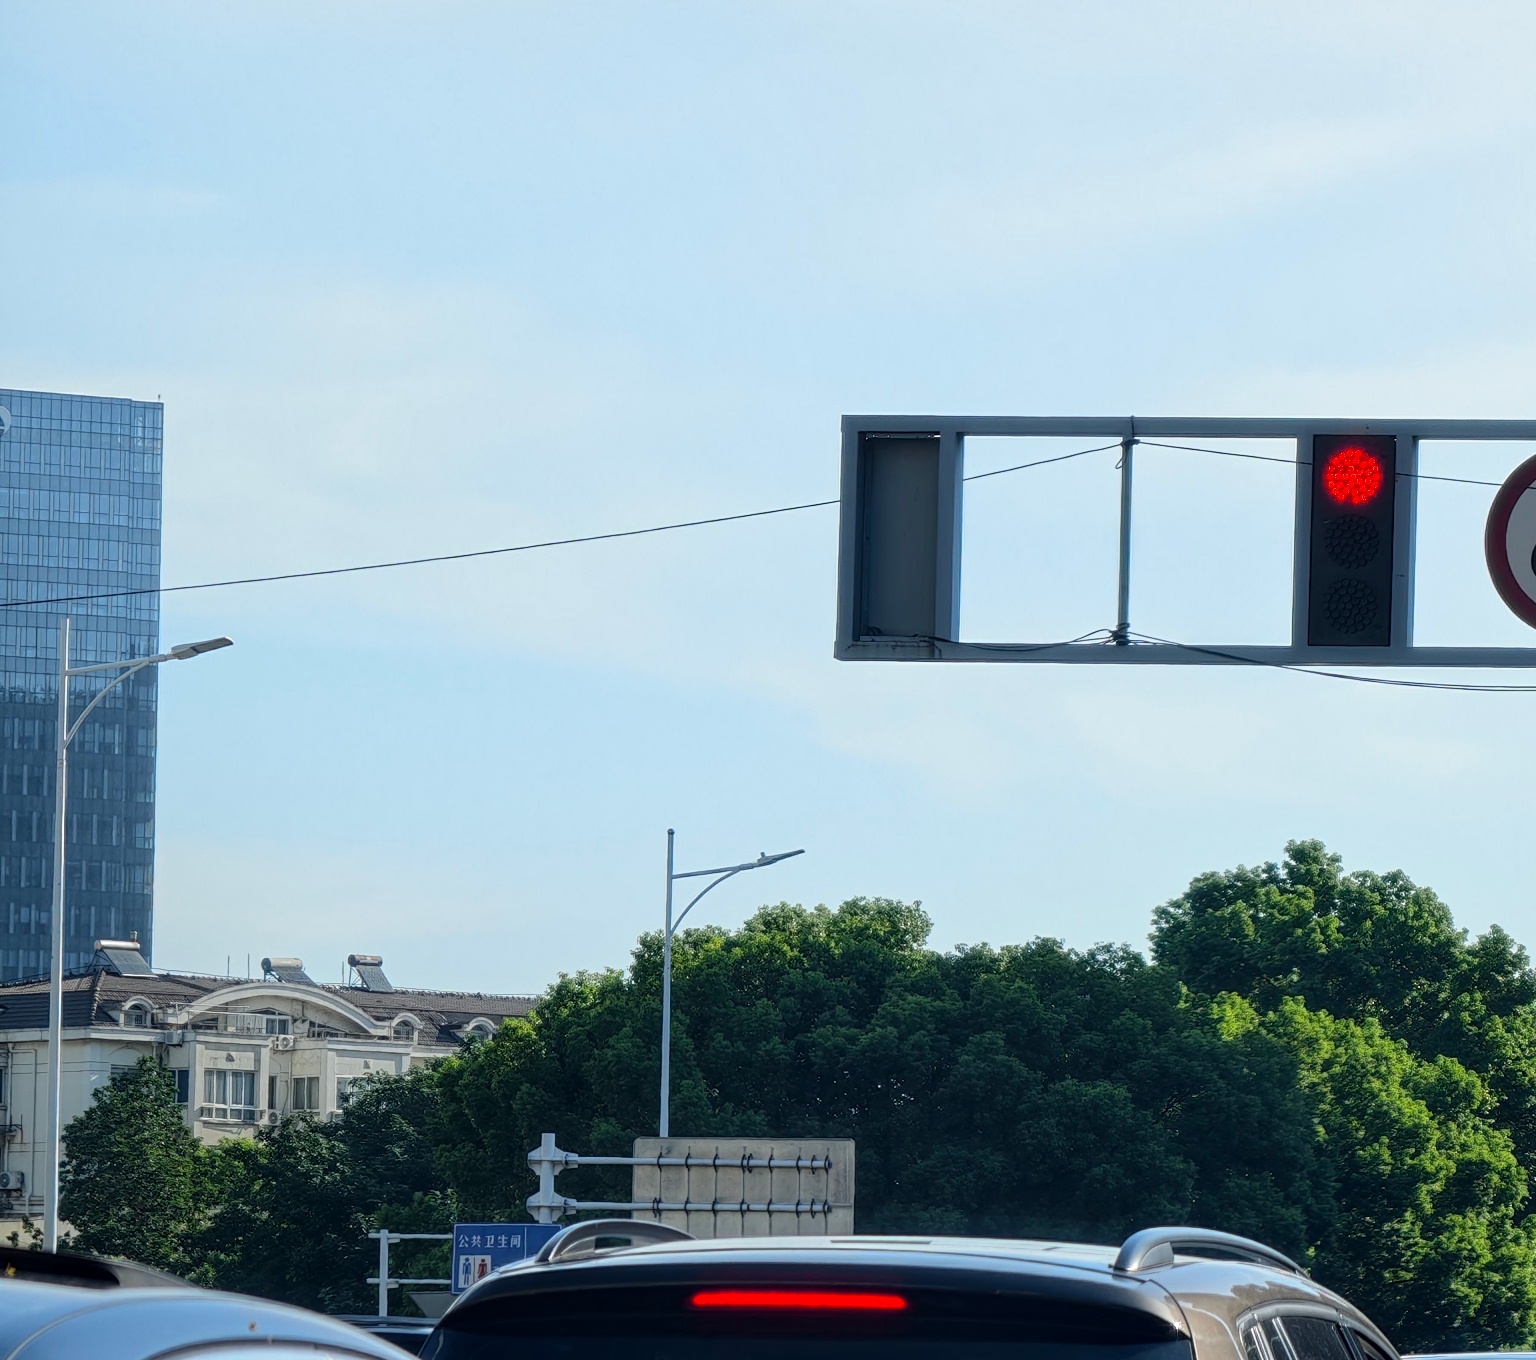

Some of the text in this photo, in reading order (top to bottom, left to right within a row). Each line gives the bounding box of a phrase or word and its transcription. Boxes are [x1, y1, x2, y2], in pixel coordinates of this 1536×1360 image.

[458, 1234, 522, 1249] 公共卫生间
